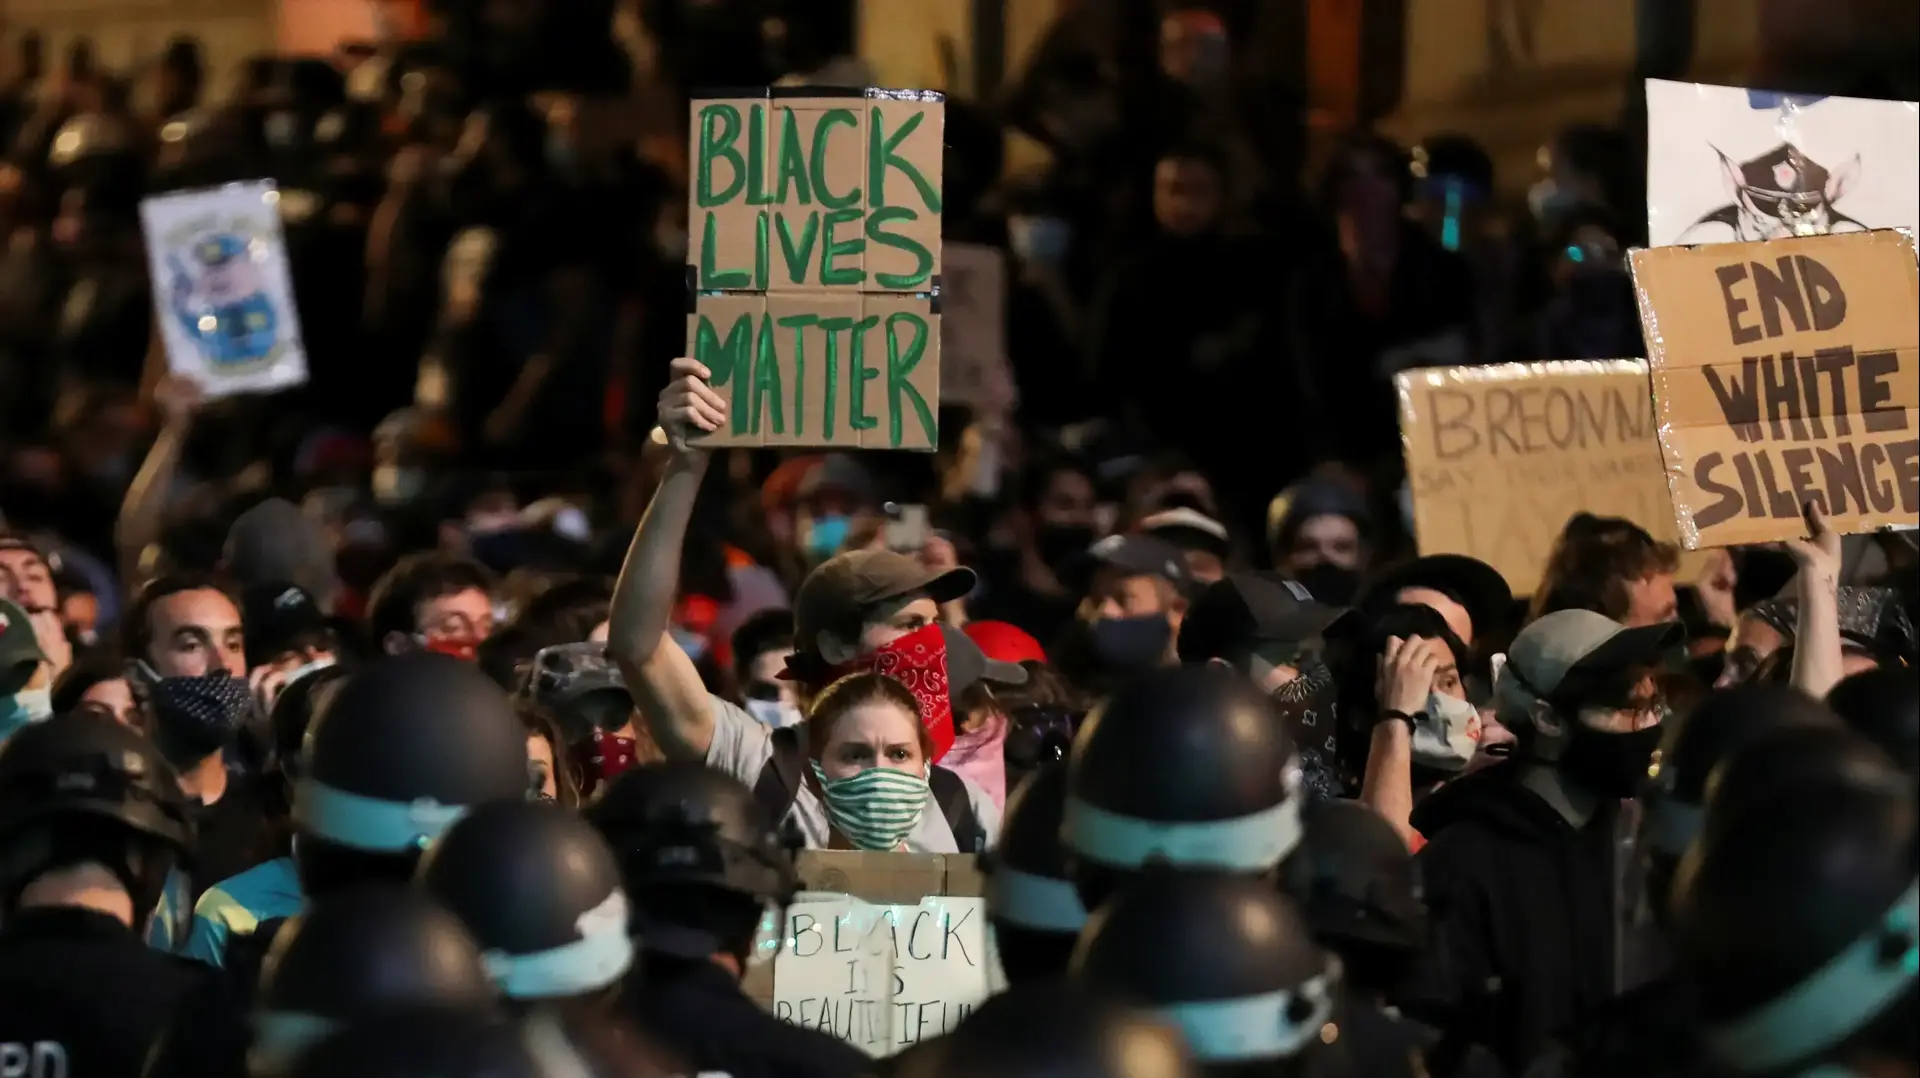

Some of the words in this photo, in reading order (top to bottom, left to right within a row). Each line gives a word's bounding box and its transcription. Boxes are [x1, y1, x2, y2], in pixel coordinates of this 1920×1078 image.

[697, 103, 942, 214] BLACK
[700, 206, 935, 290] LIVES
[1715, 254, 1847, 345] END
[694, 311, 938, 447] MATTER
[1428, 384, 1656, 459] BREONN
[1701, 345, 1909, 443] WHITE
[1692, 439, 1919, 530] SILENCE
[792, 907, 976, 966] BLACK
[844, 959, 906, 996] IS
